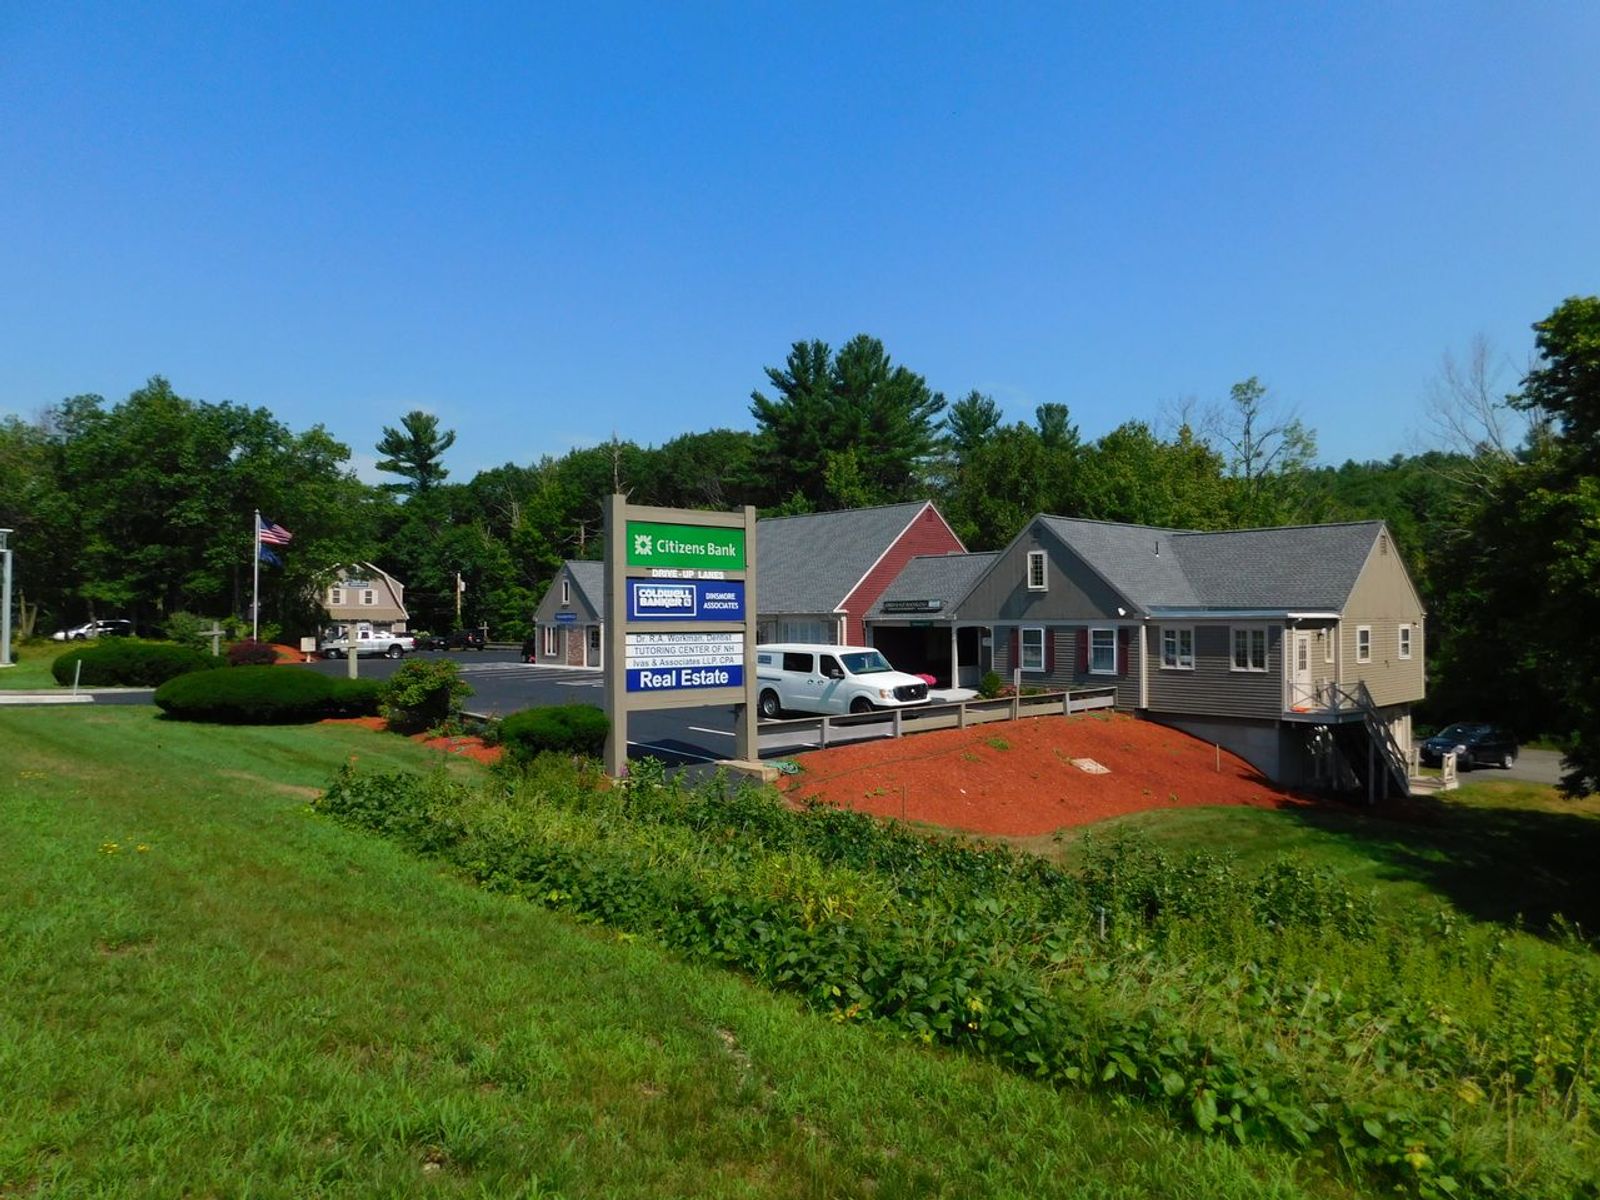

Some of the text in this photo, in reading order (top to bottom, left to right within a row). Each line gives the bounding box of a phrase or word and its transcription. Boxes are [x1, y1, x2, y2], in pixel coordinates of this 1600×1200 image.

[656, 540, 736, 557] Citizens Bank
[639, 589, 692, 598] COLDWELL
[640, 598, 682, 608] BANKER
[703, 602, 739, 610] ASSOCIATES
[635, 644, 735, 655] TUTORING CENTER OF NH
[651, 658, 658, 667] &
[660, 658, 700, 667] Associates
[719, 656, 734, 664] CPA
[640, 669, 729, 688] Real Estate
